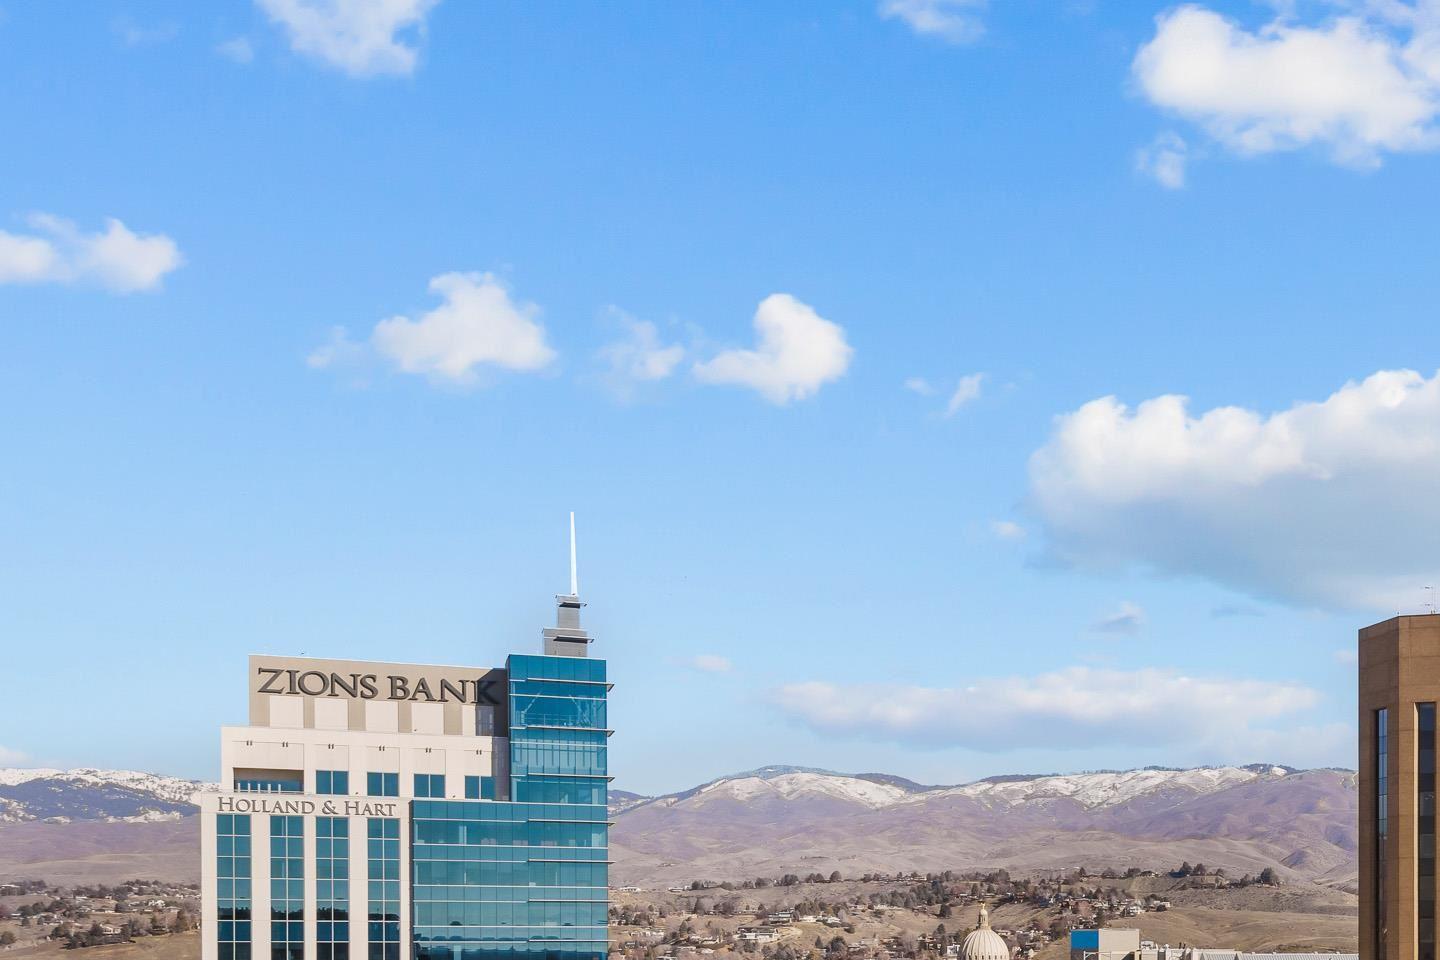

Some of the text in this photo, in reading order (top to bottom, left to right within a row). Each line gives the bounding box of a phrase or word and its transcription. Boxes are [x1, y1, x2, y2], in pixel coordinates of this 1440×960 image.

[257, 668, 501, 705] ZIONS BANK
[217, 796, 397, 816] HOLLAND & HART
